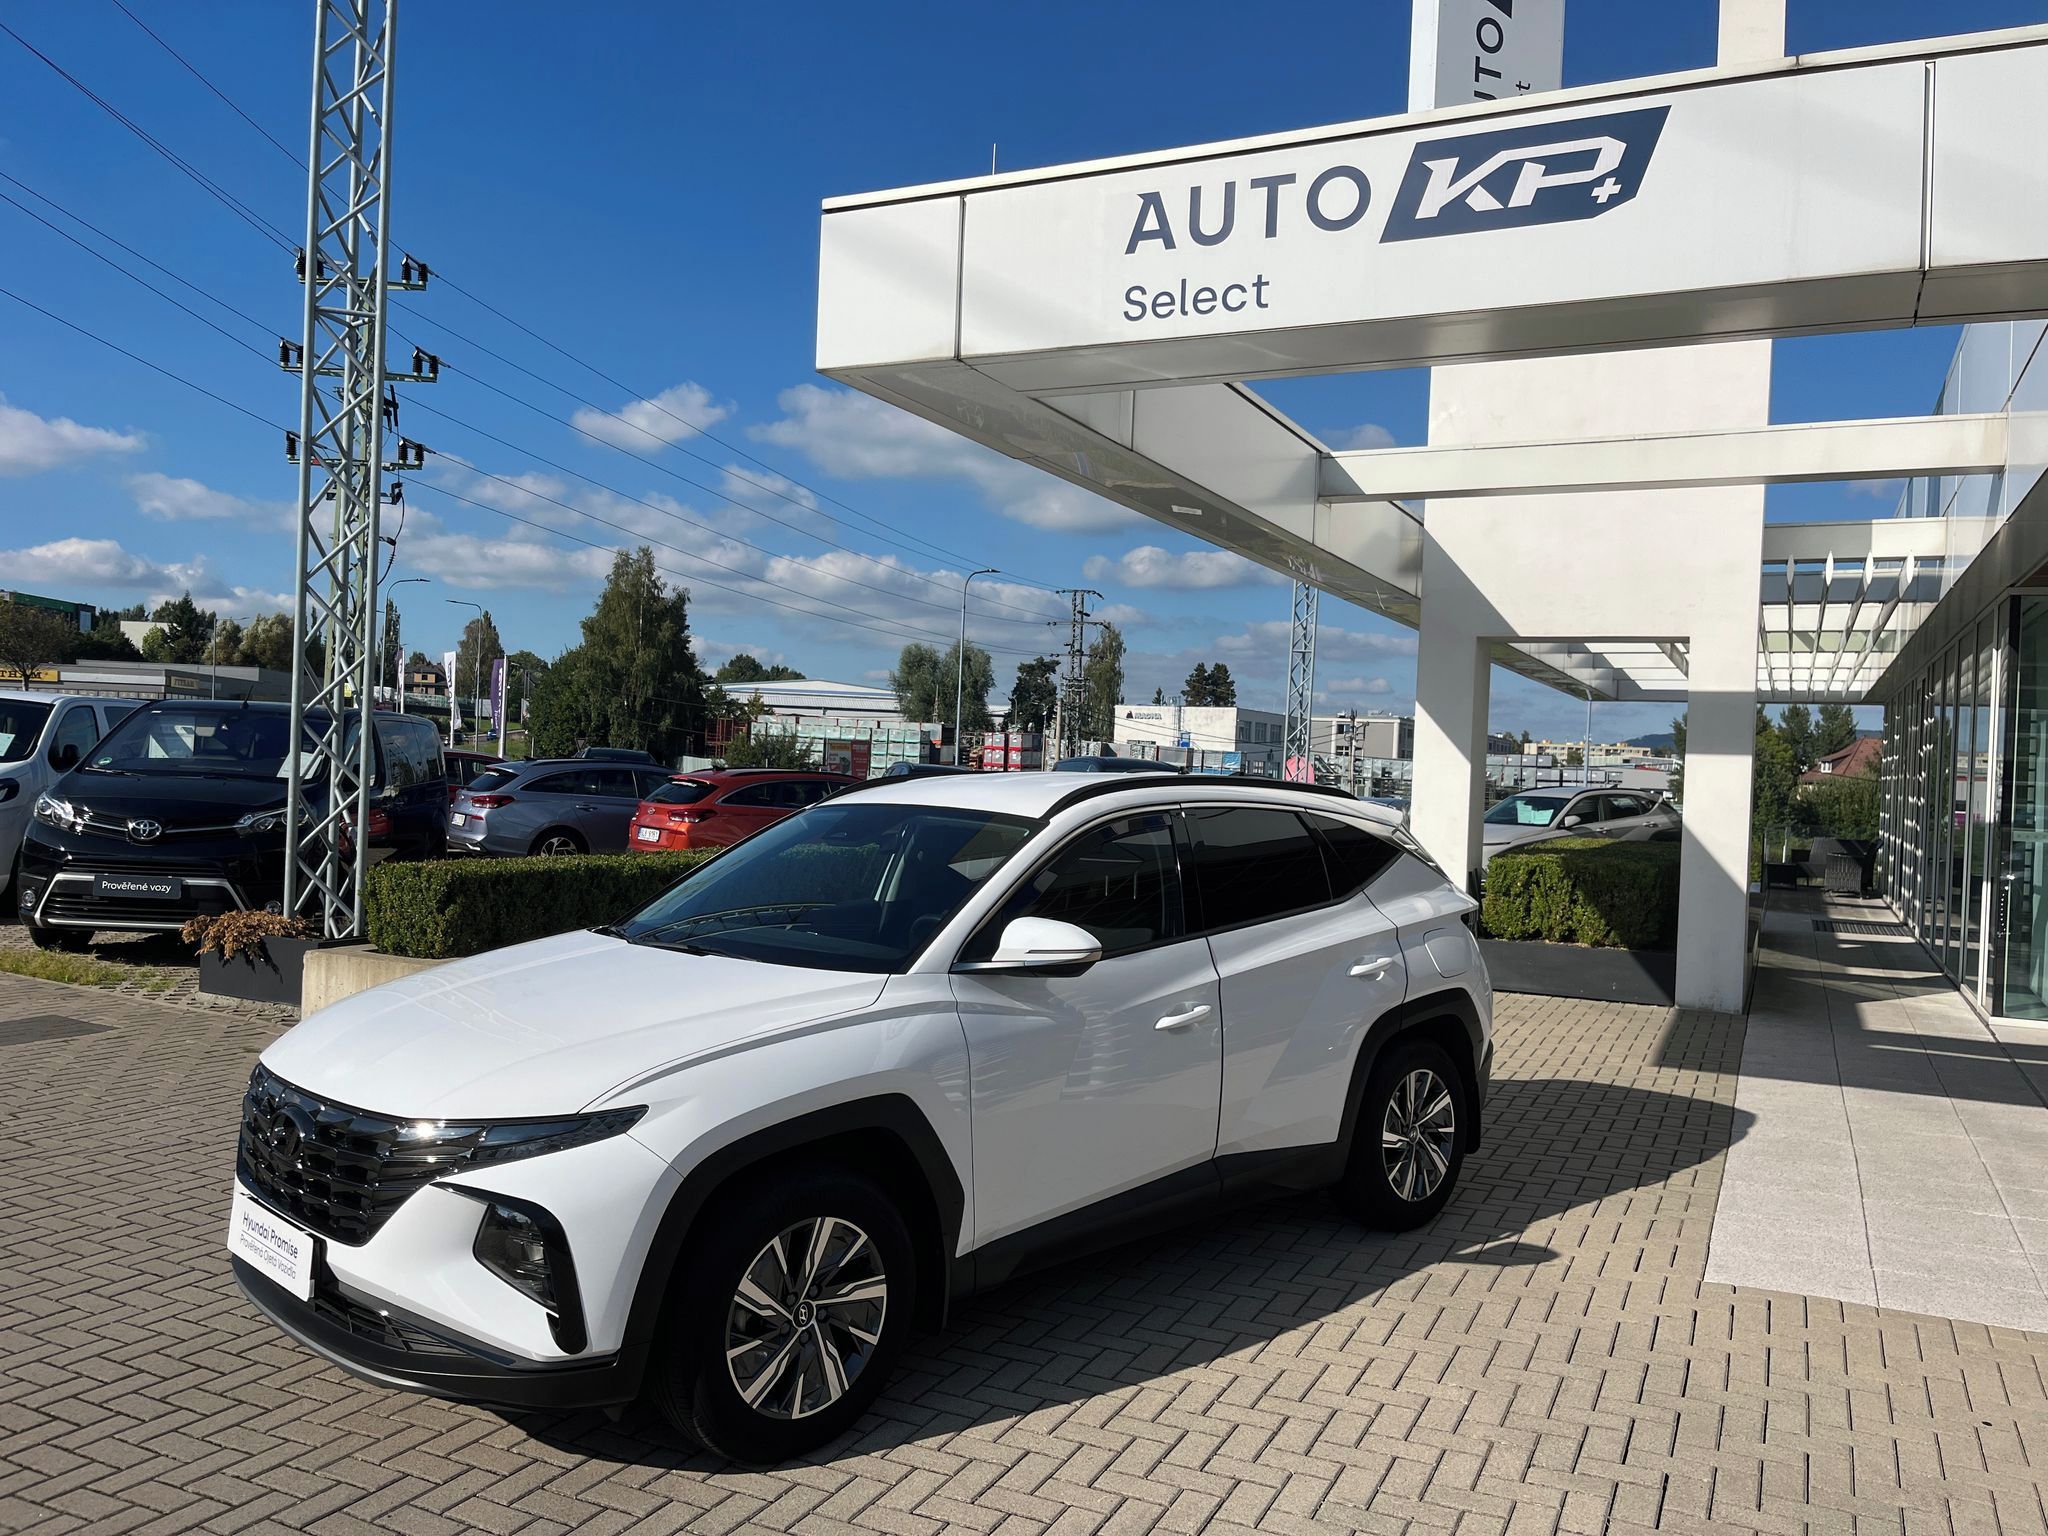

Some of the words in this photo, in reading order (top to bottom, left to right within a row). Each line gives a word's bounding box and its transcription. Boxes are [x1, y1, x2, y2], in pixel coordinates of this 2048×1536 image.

[1124, 165, 1372, 255] AUTO
[1123, 274, 1270, 322] Select
[101, 880, 149, 892] Prověřené
[149, 884, 172, 894] vozy
[242, 1211, 271, 1241] Hyundai
[269, 1228, 299, 1259] Promise
